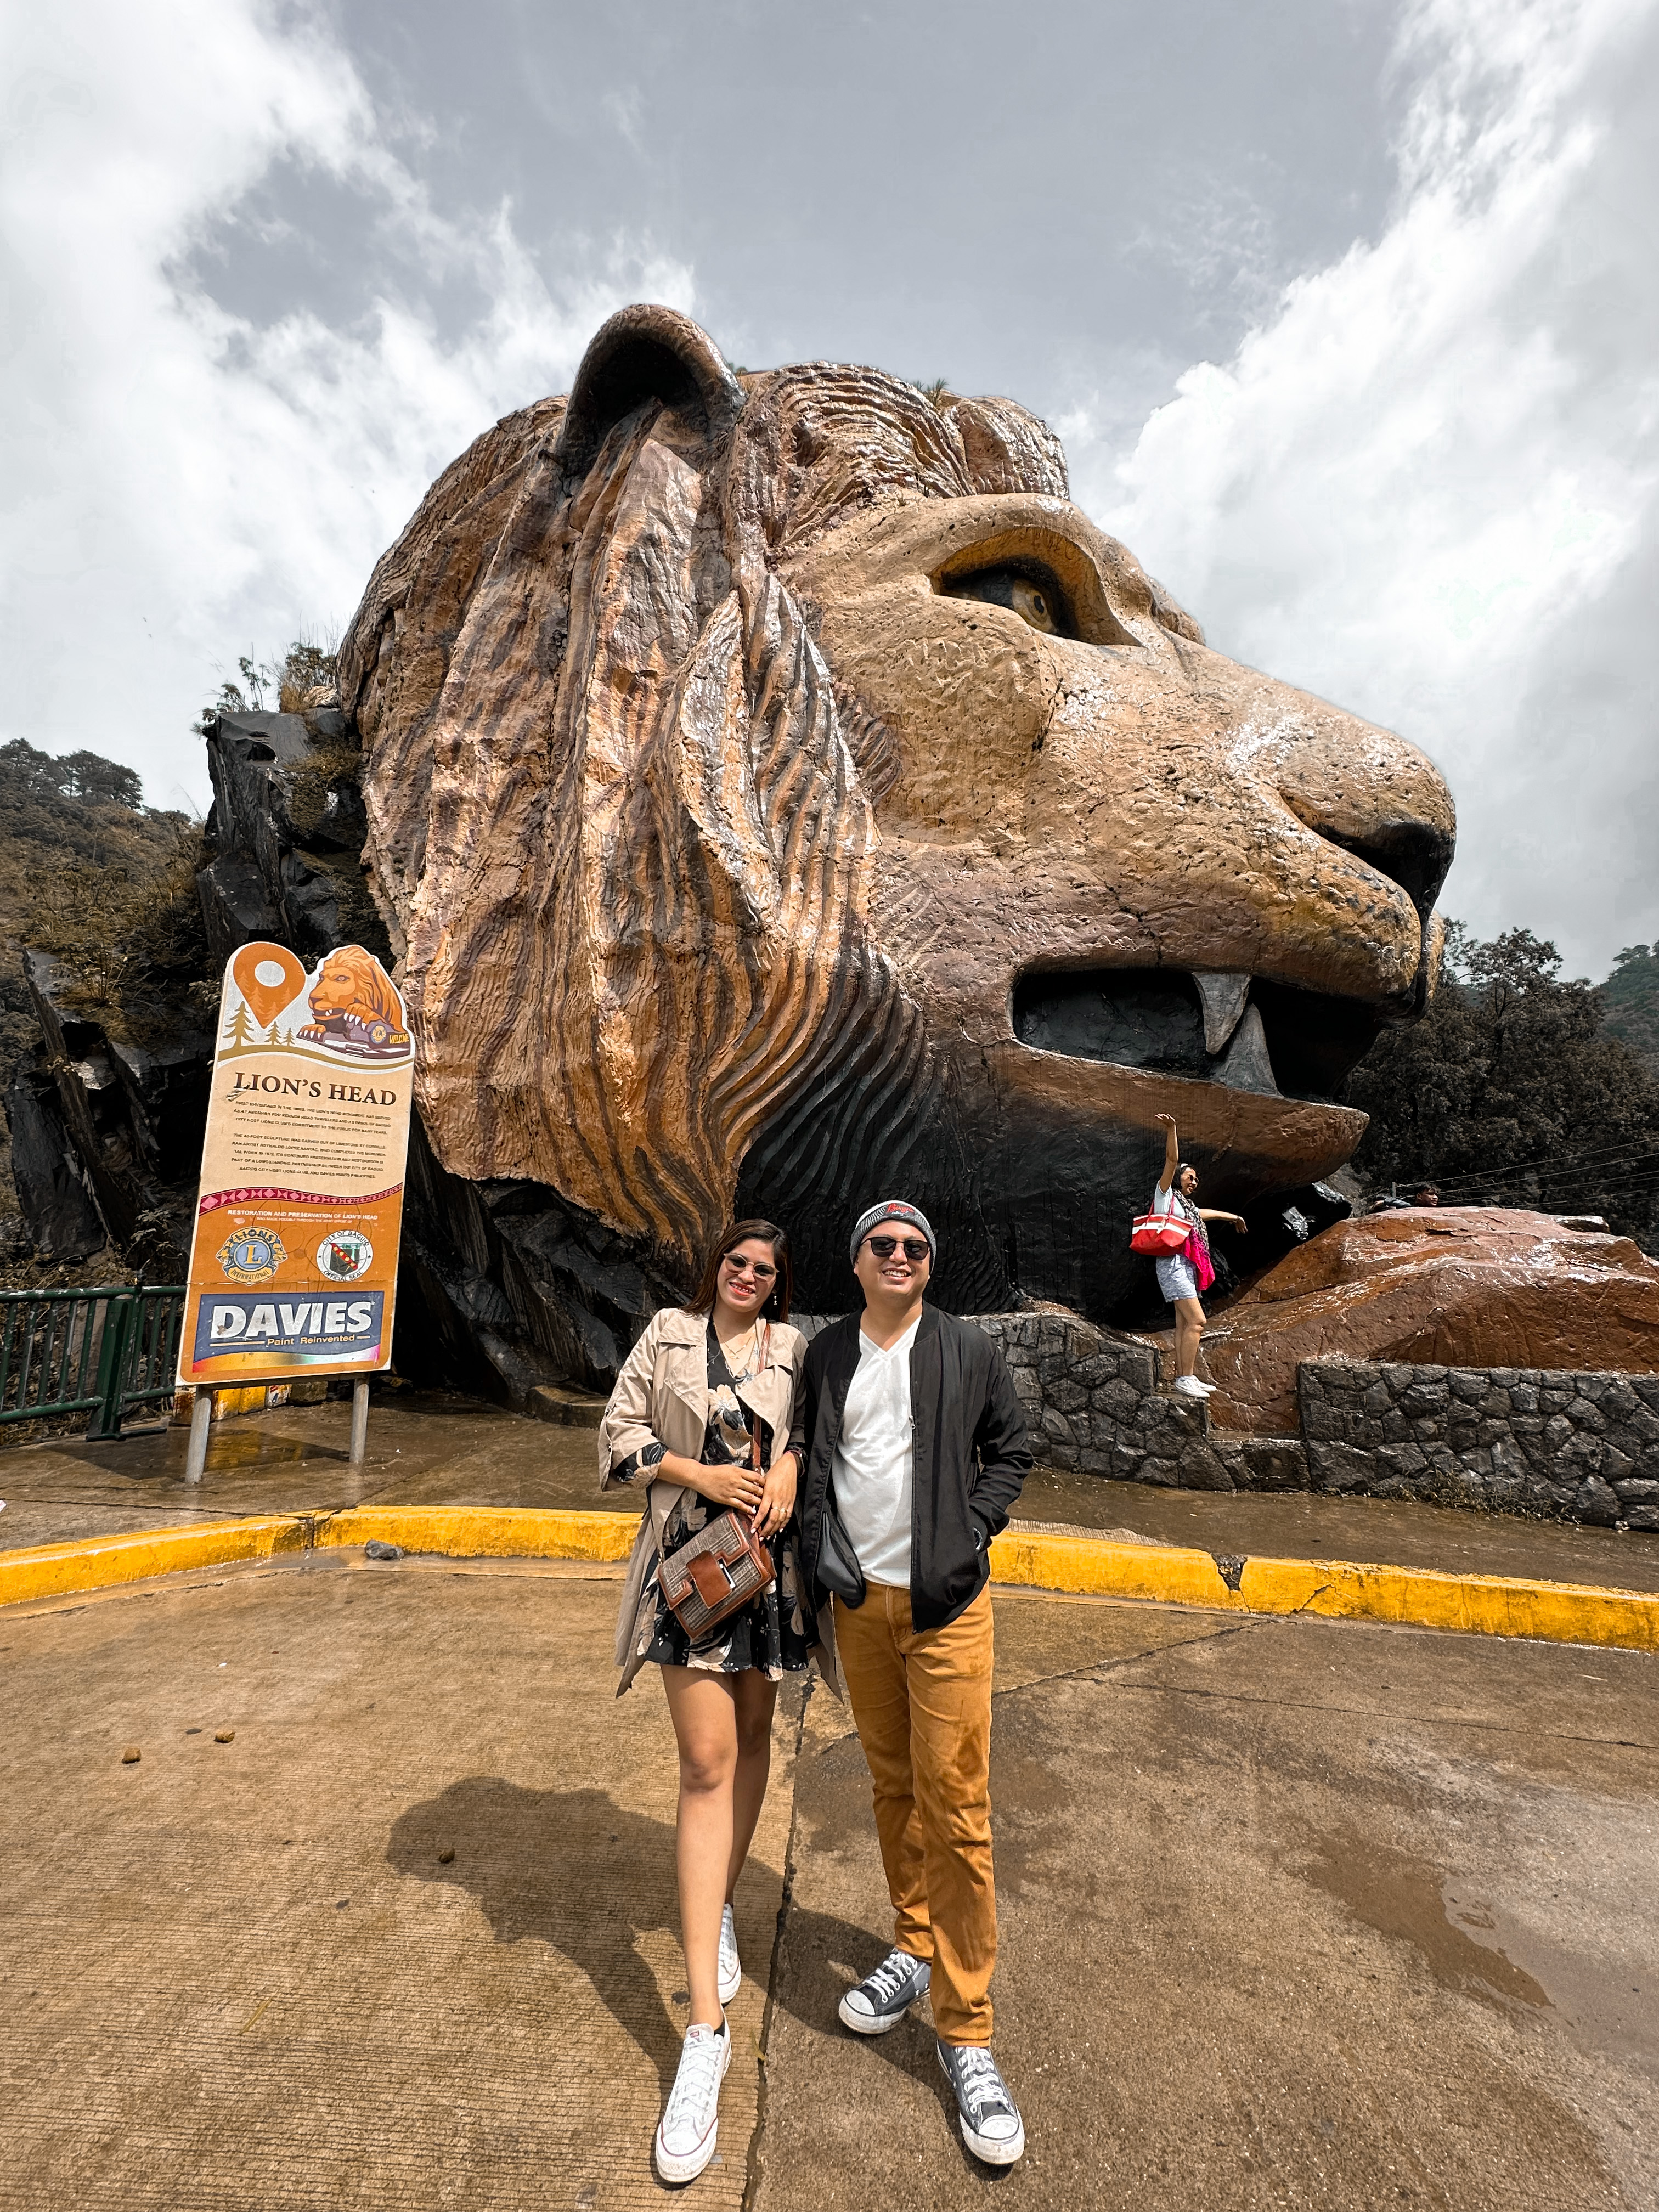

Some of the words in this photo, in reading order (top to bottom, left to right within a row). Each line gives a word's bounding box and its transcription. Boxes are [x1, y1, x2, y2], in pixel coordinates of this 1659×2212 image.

[233, 1073, 321, 1098] LION'S
[328, 1084, 397, 1105] HEAD
[235, 1229, 274, 1242] LIONS
[323, 1234, 335, 1245] CITY
[348, 1231, 369, 1246] BAGUIO
[244, 1245, 262, 1264] L
[230, 1269, 269, 1279] INTERNATIONAL
[324, 1271, 347, 1281] OFFICIAL
[349, 1271, 363, 1280] SEAL
[210, 1301, 372, 1339] DAVIES
[301, 1335, 354, 1344] Reinvented
